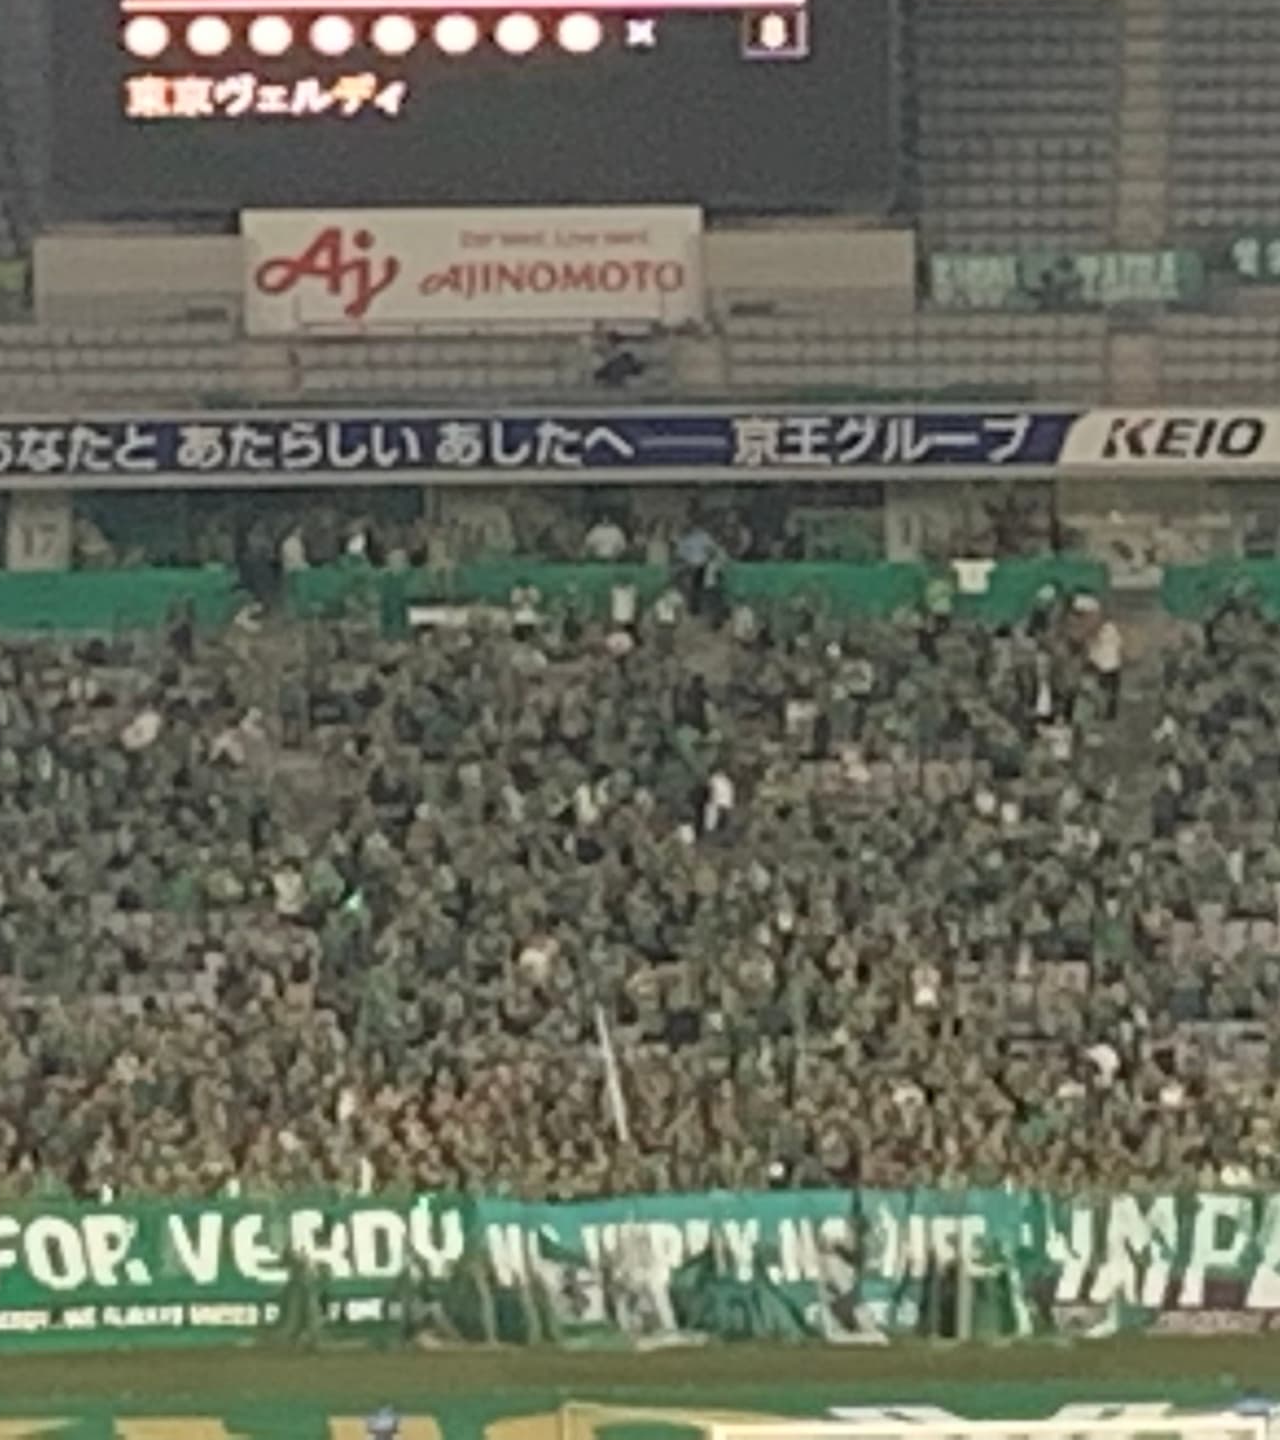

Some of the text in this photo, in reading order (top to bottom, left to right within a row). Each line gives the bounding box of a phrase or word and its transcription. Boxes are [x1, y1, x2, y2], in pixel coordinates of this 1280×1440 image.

[419, 260, 685, 299] AJINOMOTO
[177, 424, 420, 470] あたらしい
[435, 420, 636, 467] あしたへ
[1100, 417, 1266, 460] KEIO
[169, 1208, 465, 1284] VERDY
